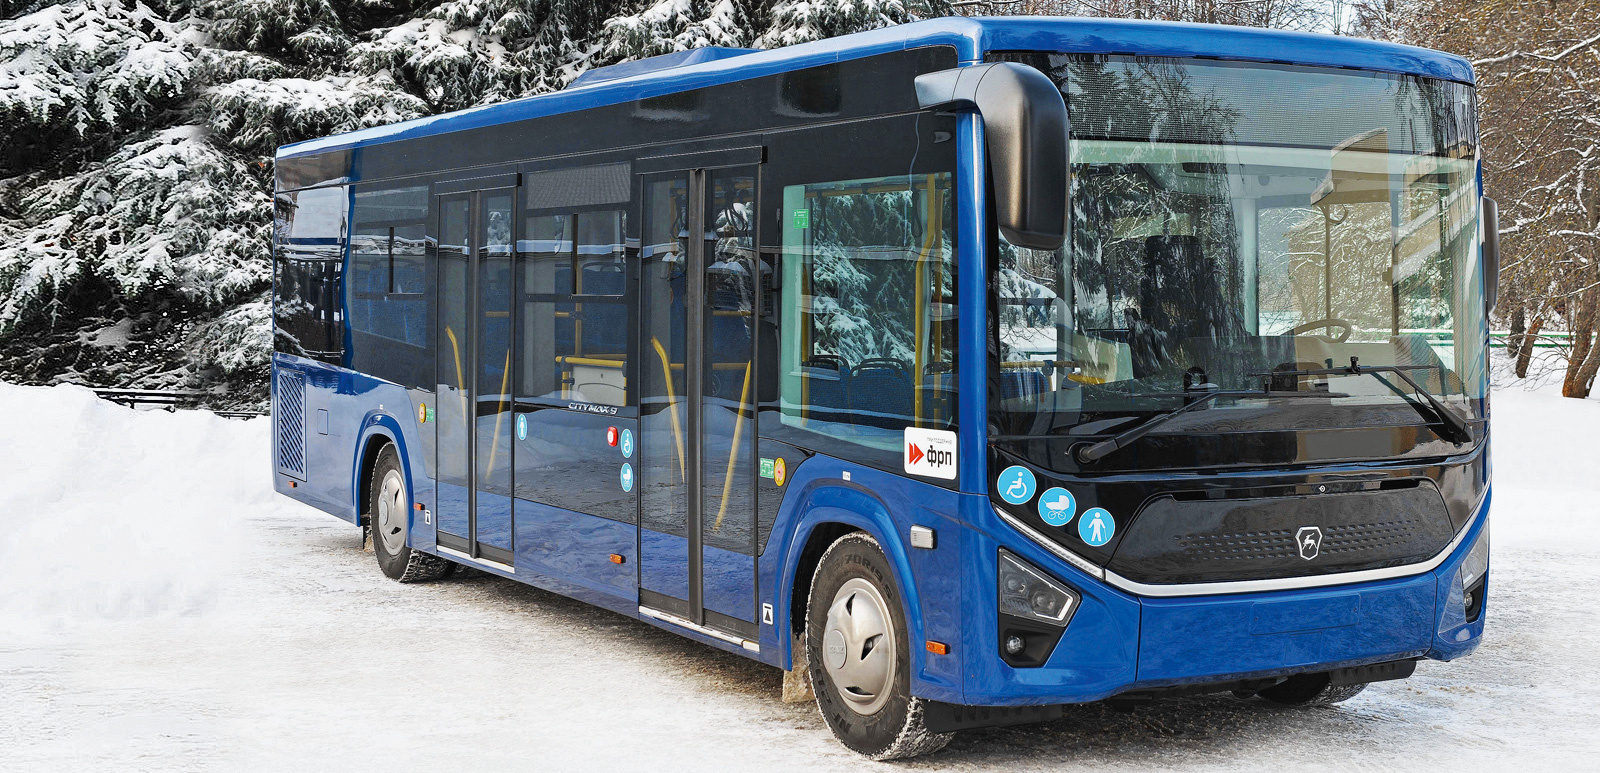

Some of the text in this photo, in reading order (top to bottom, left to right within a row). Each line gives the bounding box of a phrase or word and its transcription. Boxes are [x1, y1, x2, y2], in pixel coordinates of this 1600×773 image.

[568, 402, 618, 415] CITYMAX 9
[926, 444, 952, 468] фрп
